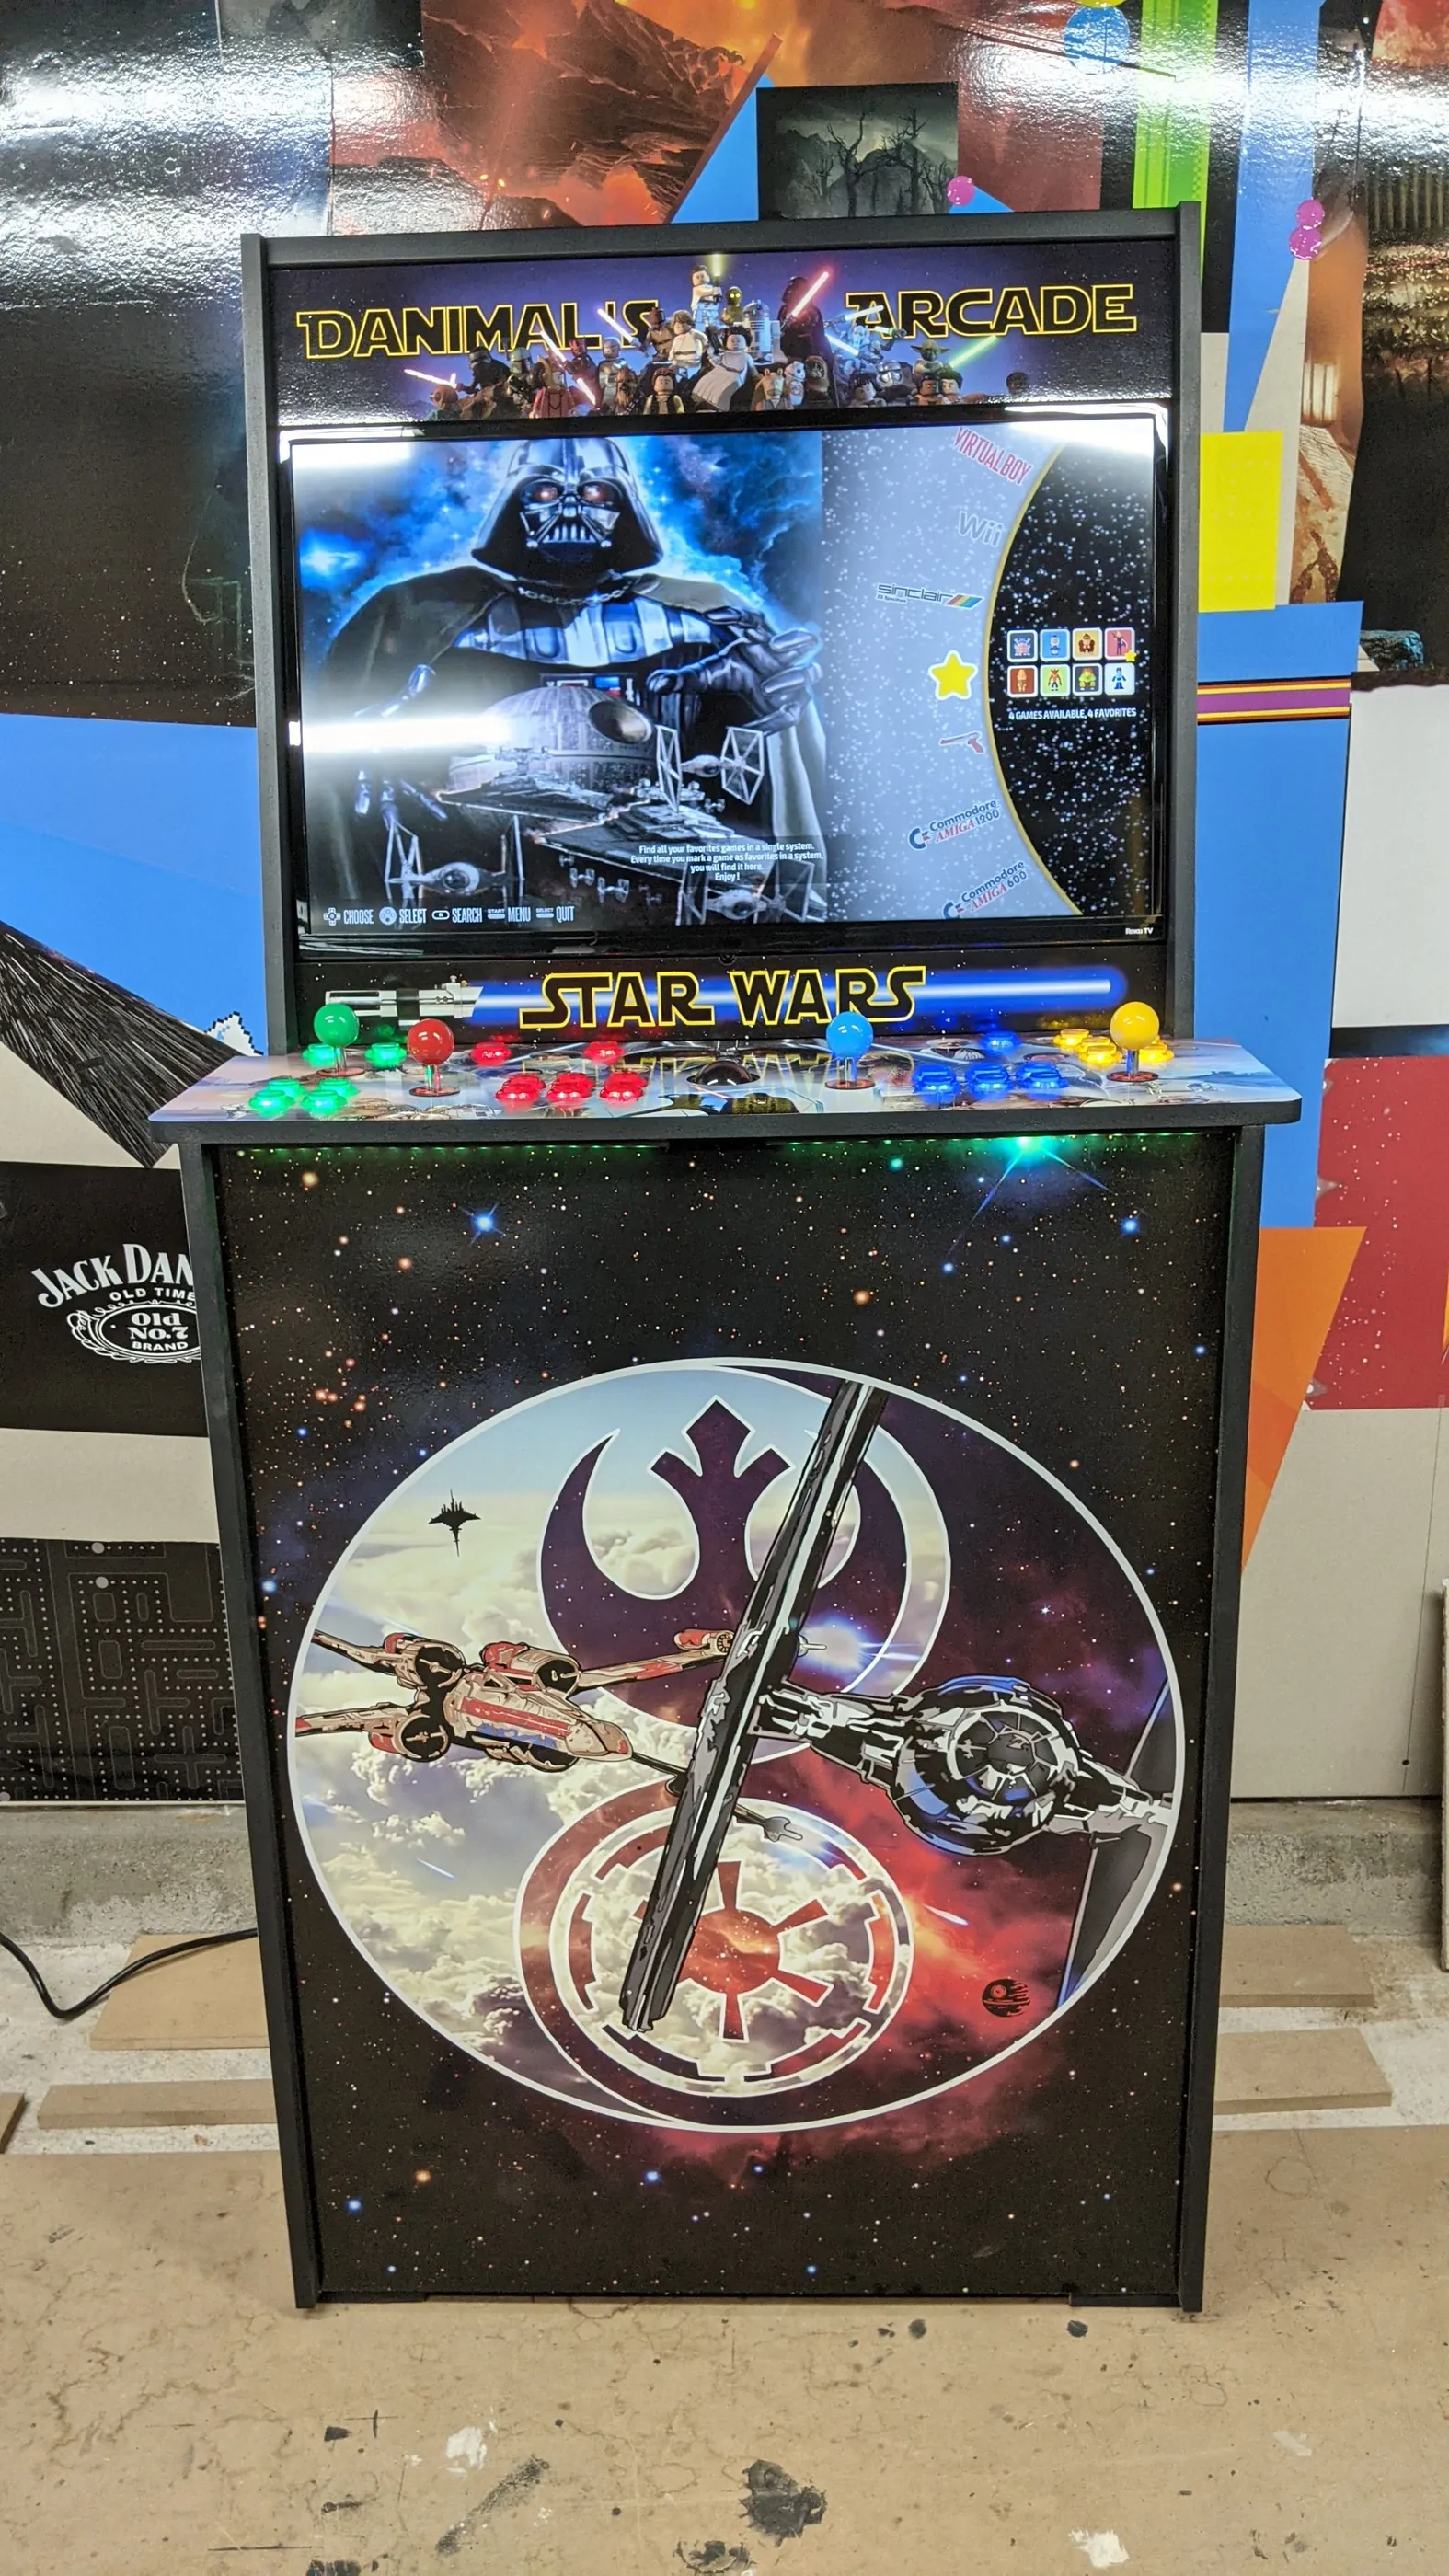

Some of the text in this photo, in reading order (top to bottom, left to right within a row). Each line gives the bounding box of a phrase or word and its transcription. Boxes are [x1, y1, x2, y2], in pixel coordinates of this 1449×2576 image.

[845, 283, 1137, 339] ARCADE
[953, 427, 1033, 485] VIRTUAL BOY
[958, 512, 1005, 547] Wii
[878, 583, 953, 602] sinclair
[1008, 707, 1137, 720] 4 GAMES AVAILABLE, 4 FAVORITES
[929, 800, 997, 832] Commodore
[936, 809, 1000, 842] AMIGA 1200
[630, 855, 652, 865] Every
[653, 855, 671, 863] time
[672, 856, 685, 864] you
[686, 854, 706, 862] mark
[712, 855, 734, 863] game
[744, 852, 778, 861] favorites
[779, 851, 788, 859] in
[639, 845, 656, 854] Find
[657, 845, 667, 854] all
[668, 845, 685, 855] your
[686, 844, 720, 853] favorites
[721, 845, 745, 854] games
[746, 843, 754, 851] in
[762, 843, 785, 853] single
[785, 842, 815, 852] system.
[690, 865, 705, 873] you
[720, 863, 736, 871] find
[737, 862, 743, 870] it
[744, 862, 764, 870] here.
[715, 872, 736, 882] Enjoy
[961, 861, 1025, 903] Commodore
[971, 870, 1028, 911] AMIGA 600
[343, 909, 374, 925] CHOOSE
[398, 908, 428, 924] SELECT
[452, 907, 483, 923] SEARCH
[508, 906, 531, 922] MENU
[556, 905, 575, 923] QUIT
[1144, 926, 1154, 935] TV
[519, 965, 926, 1029] STAR WARS
[31, 1254, 124, 1308] JACK
[109, 1287, 195, 1302] OLD TIME
[131, 1312, 182, 1327] Old
[132, 1341, 189, 1351] BRAND
